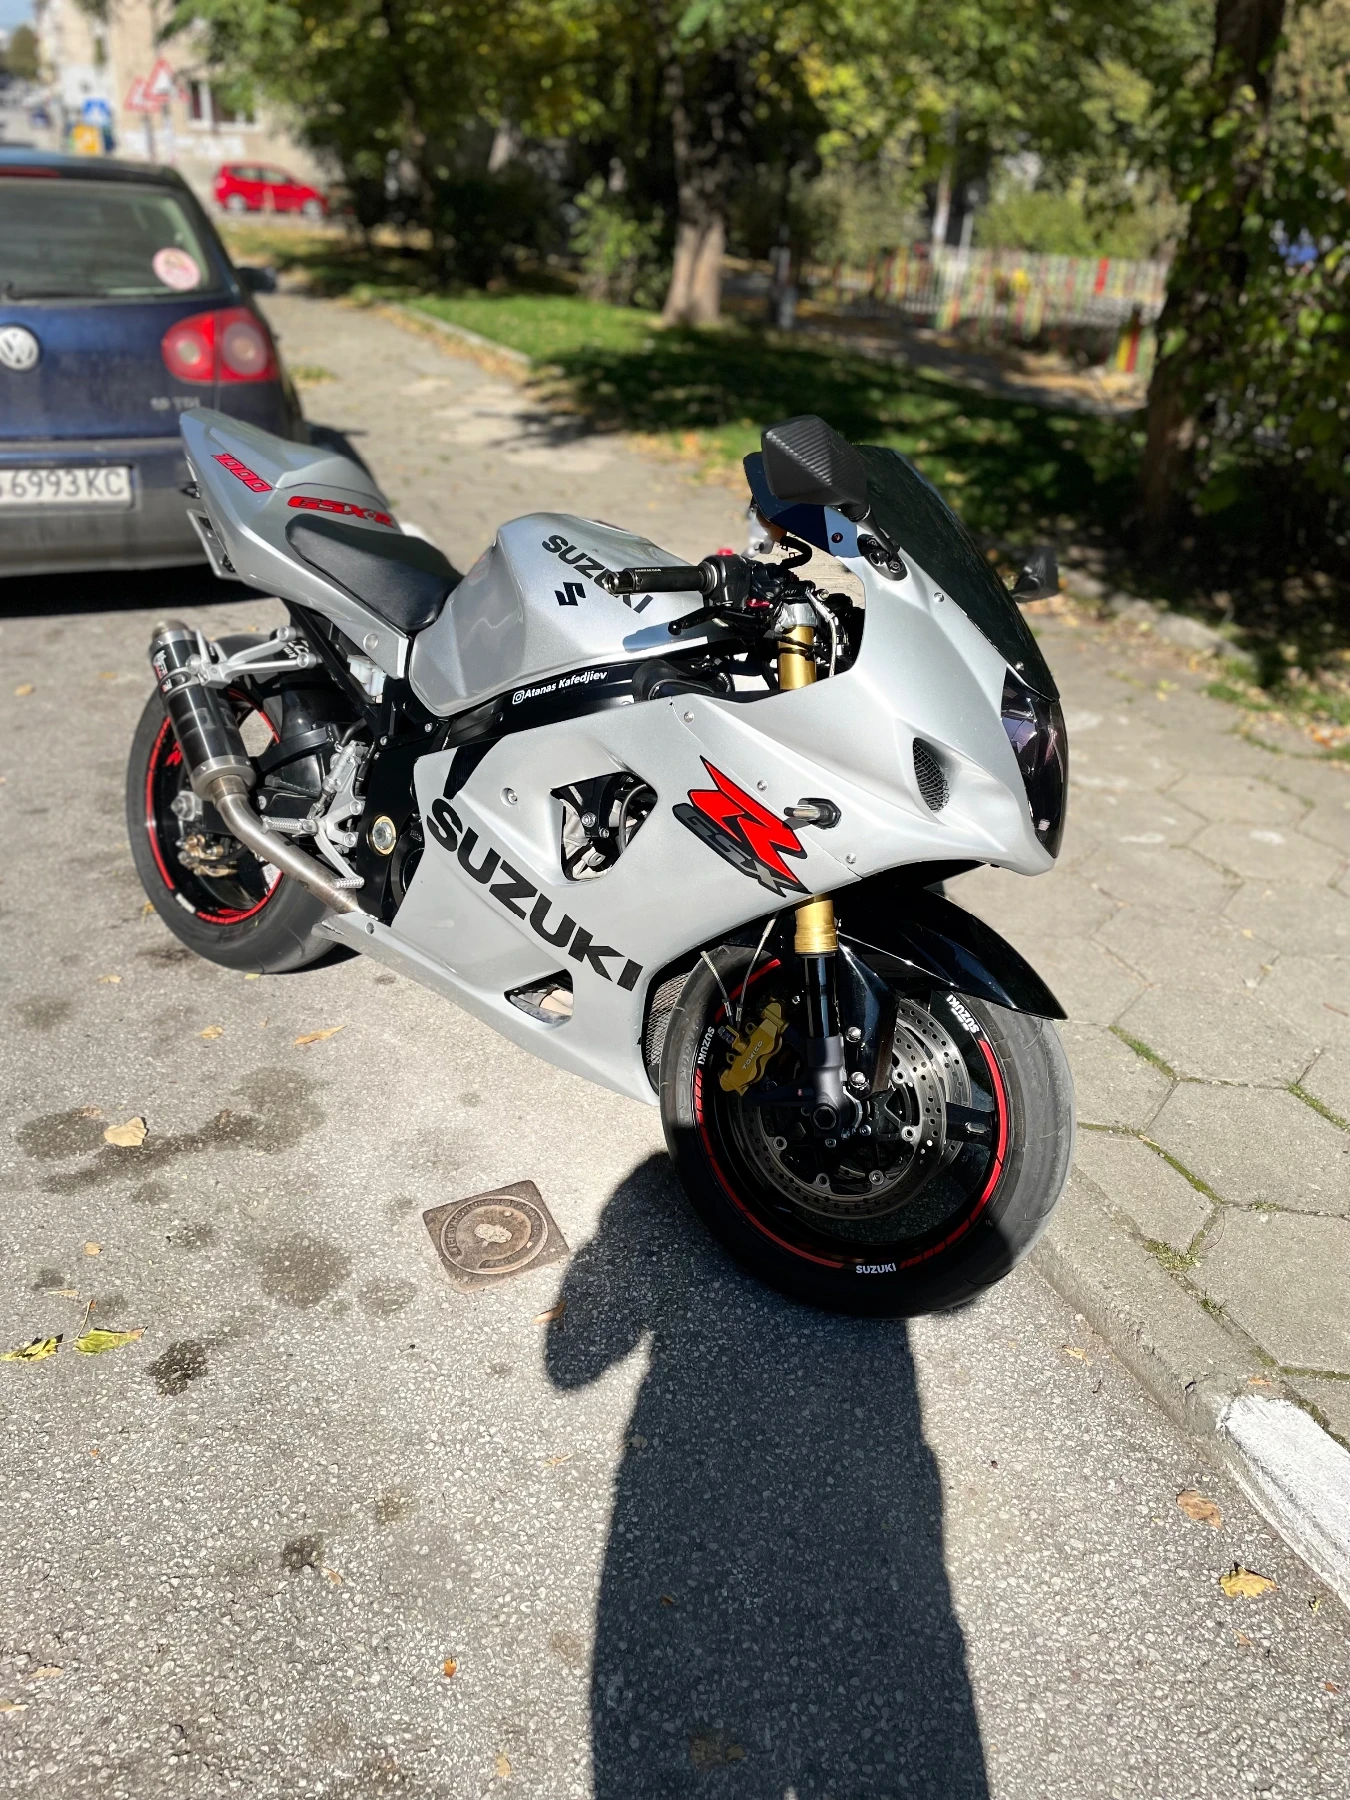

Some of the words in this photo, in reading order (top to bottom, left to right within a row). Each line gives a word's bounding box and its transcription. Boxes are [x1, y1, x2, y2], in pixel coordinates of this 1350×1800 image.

[211, 453, 273, 493] 1000
[541, 534, 654, 614] SUZI
[524, 683, 557, 699] Atanas
[558, 671, 608, 689] Kafedjiev
[426, 798, 644, 992] SUZUKI
[945, 994, 980, 1034] SUZUKI
[697, 1026, 715, 1065] SUZUKI
[855, 1262, 897, 1274] SUZUKI
